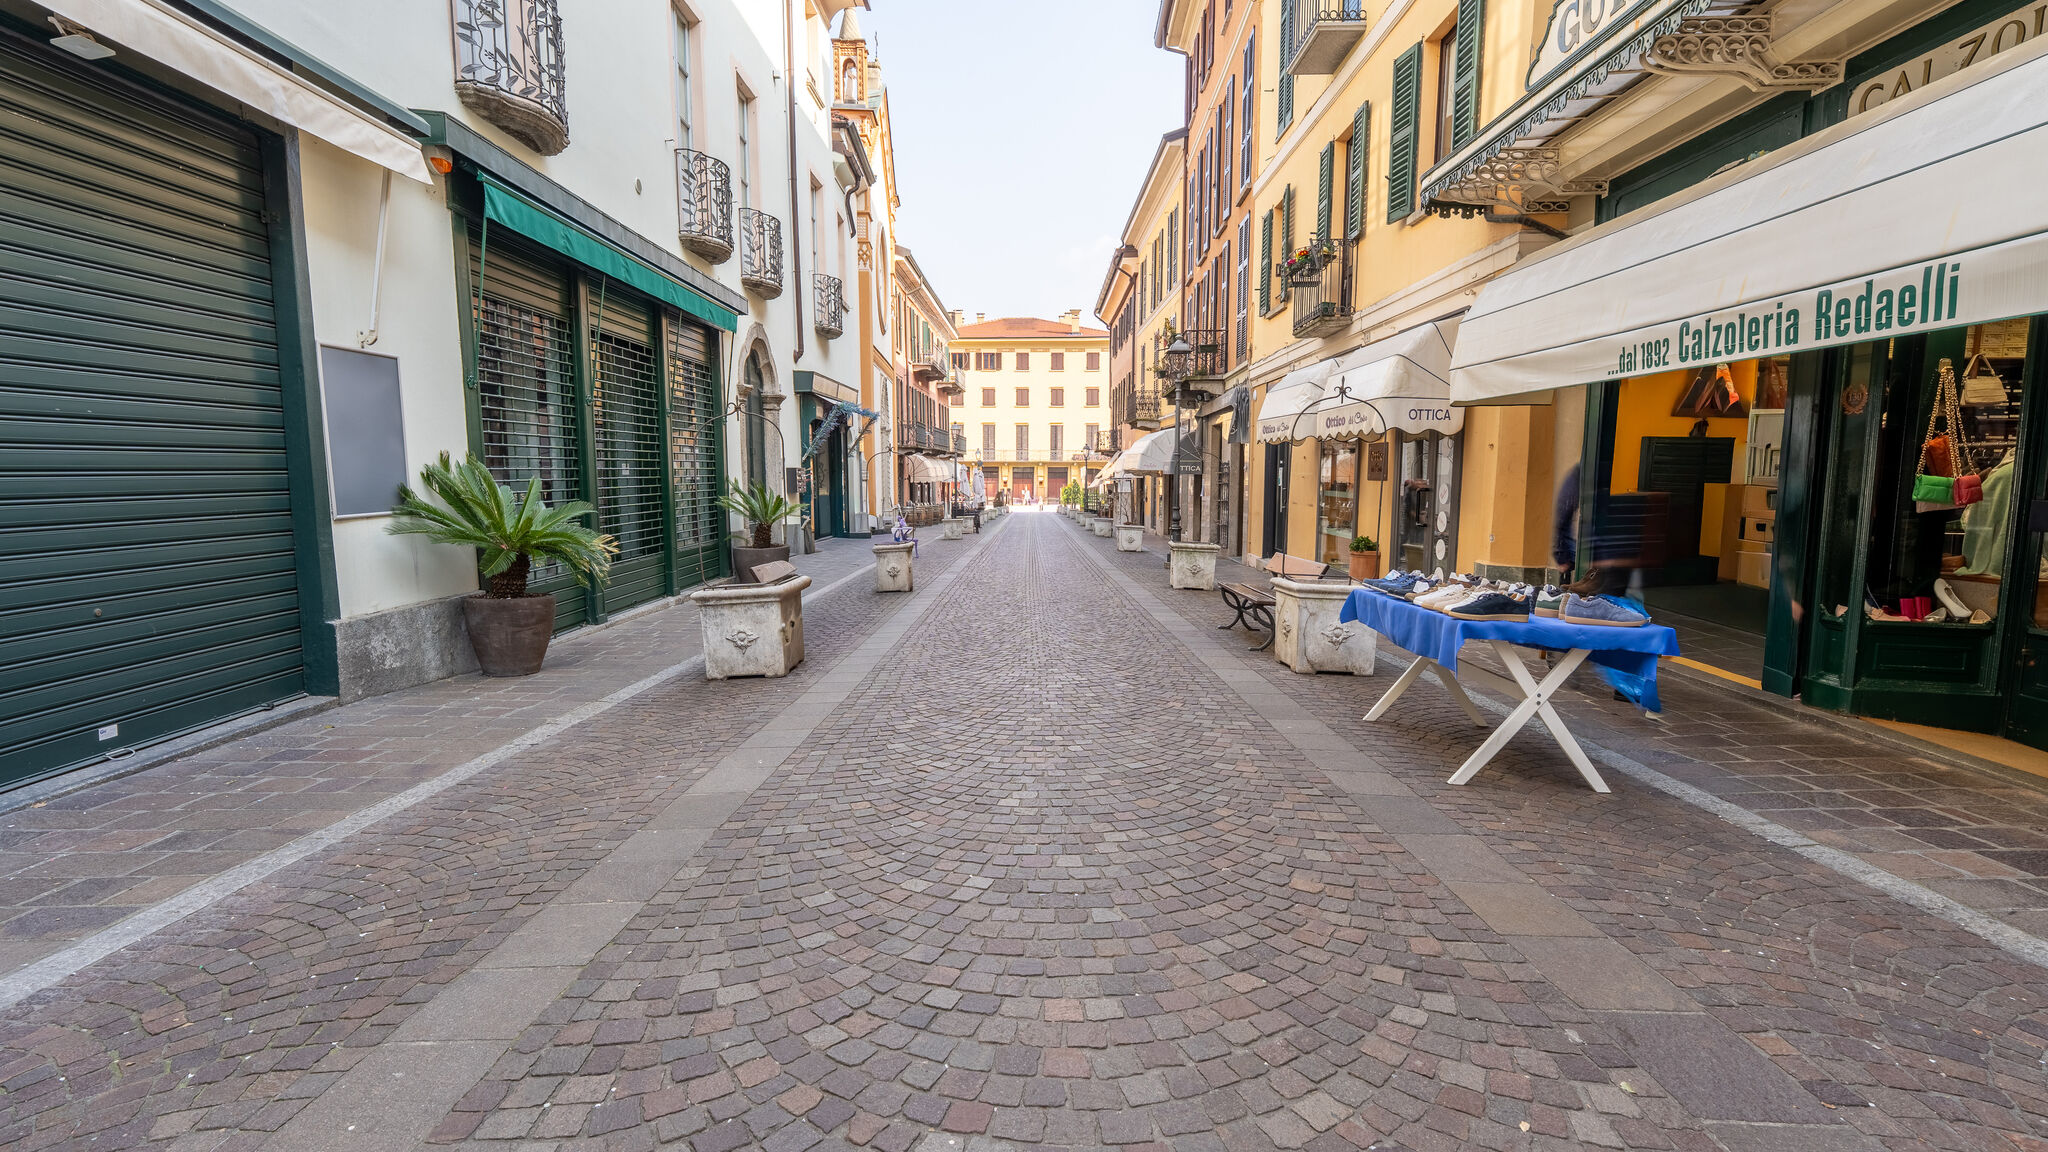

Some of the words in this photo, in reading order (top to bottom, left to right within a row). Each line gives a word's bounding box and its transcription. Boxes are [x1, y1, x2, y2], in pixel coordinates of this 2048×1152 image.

[1557, 0, 1627, 53] GU
[1640, 337, 1670, 369] 1892
[1678, 302, 1800, 364] Calzoleria
[1814, 262, 1961, 341] Redaelli
[1325, 416, 1346, 429] Ottico
[1408, 408, 1452, 421] OTTICA
